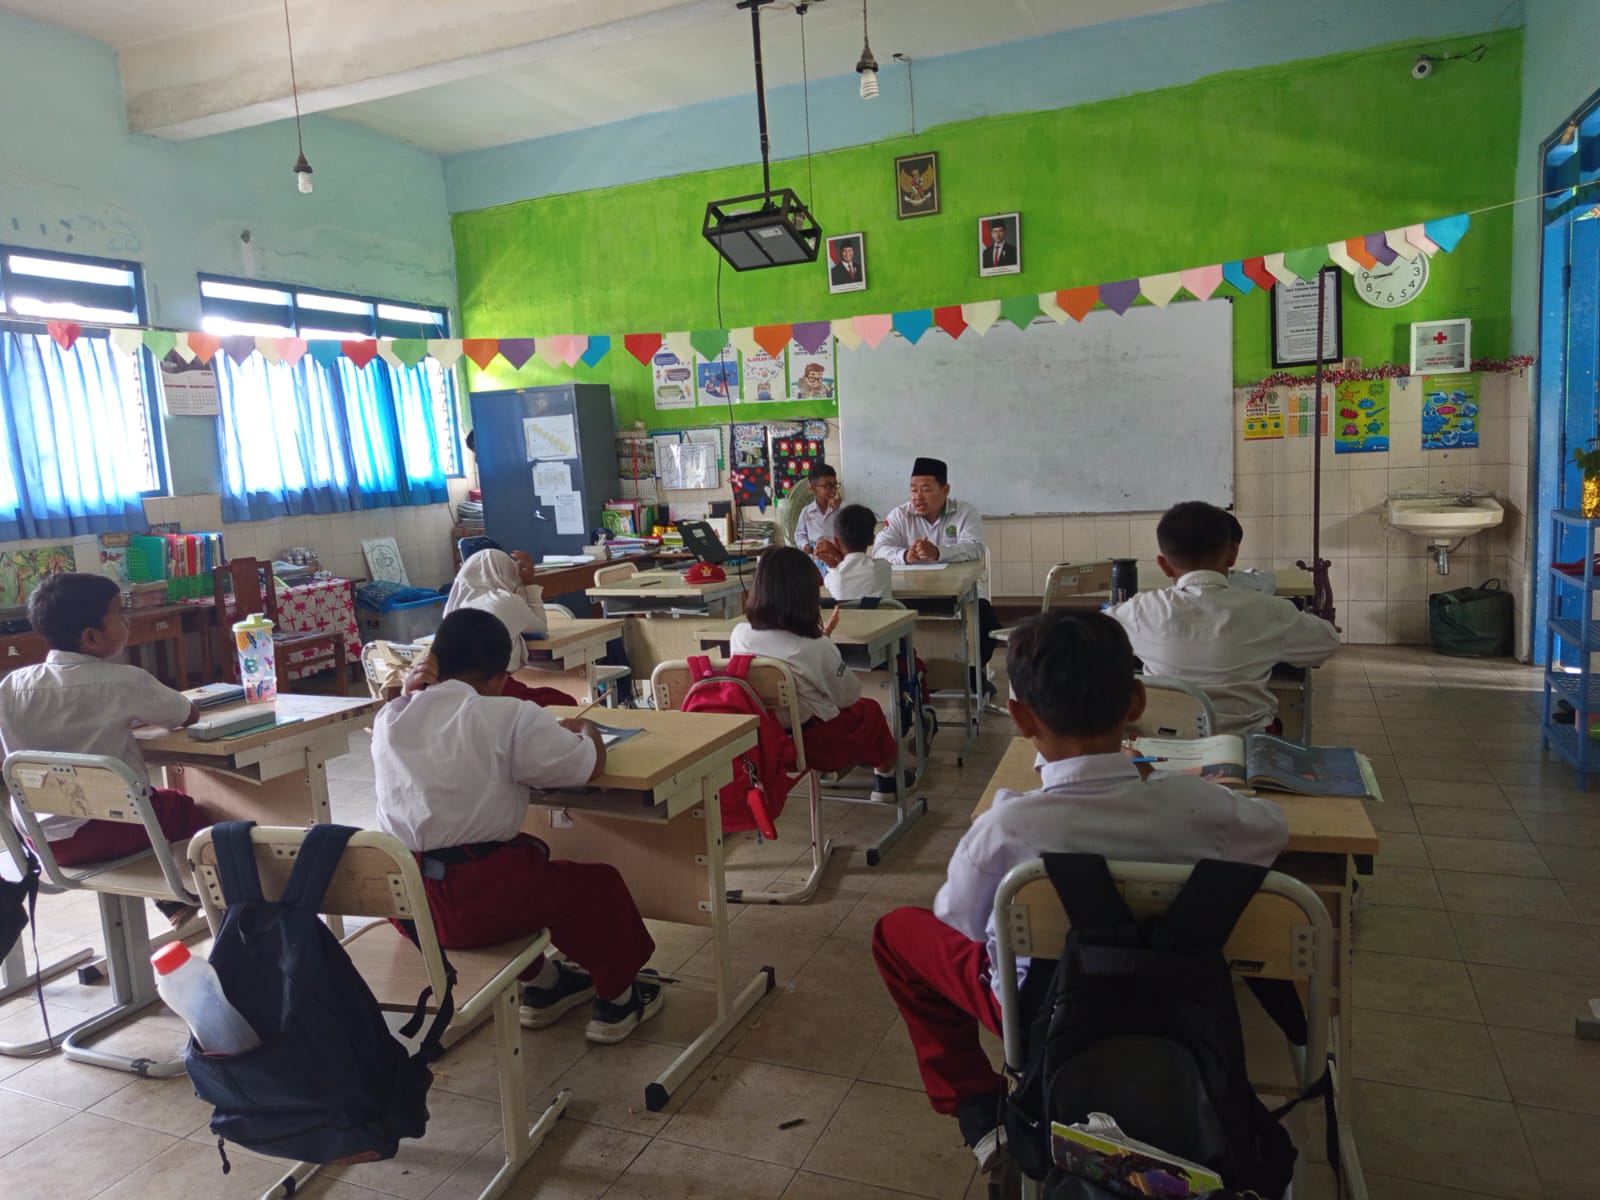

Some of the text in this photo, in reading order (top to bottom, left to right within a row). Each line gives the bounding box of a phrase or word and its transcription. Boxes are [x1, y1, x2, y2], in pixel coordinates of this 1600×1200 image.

[1413, 267, 1420, 276] 3
[1362, 272, 1369, 281] 9
[1366, 283, 1372, 292] 8
[1408, 280, 1415, 288] 4
[1375, 291, 1382, 300] 7
[1387, 292, 1394, 302] 6
[1400, 289, 1407, 298] 5
